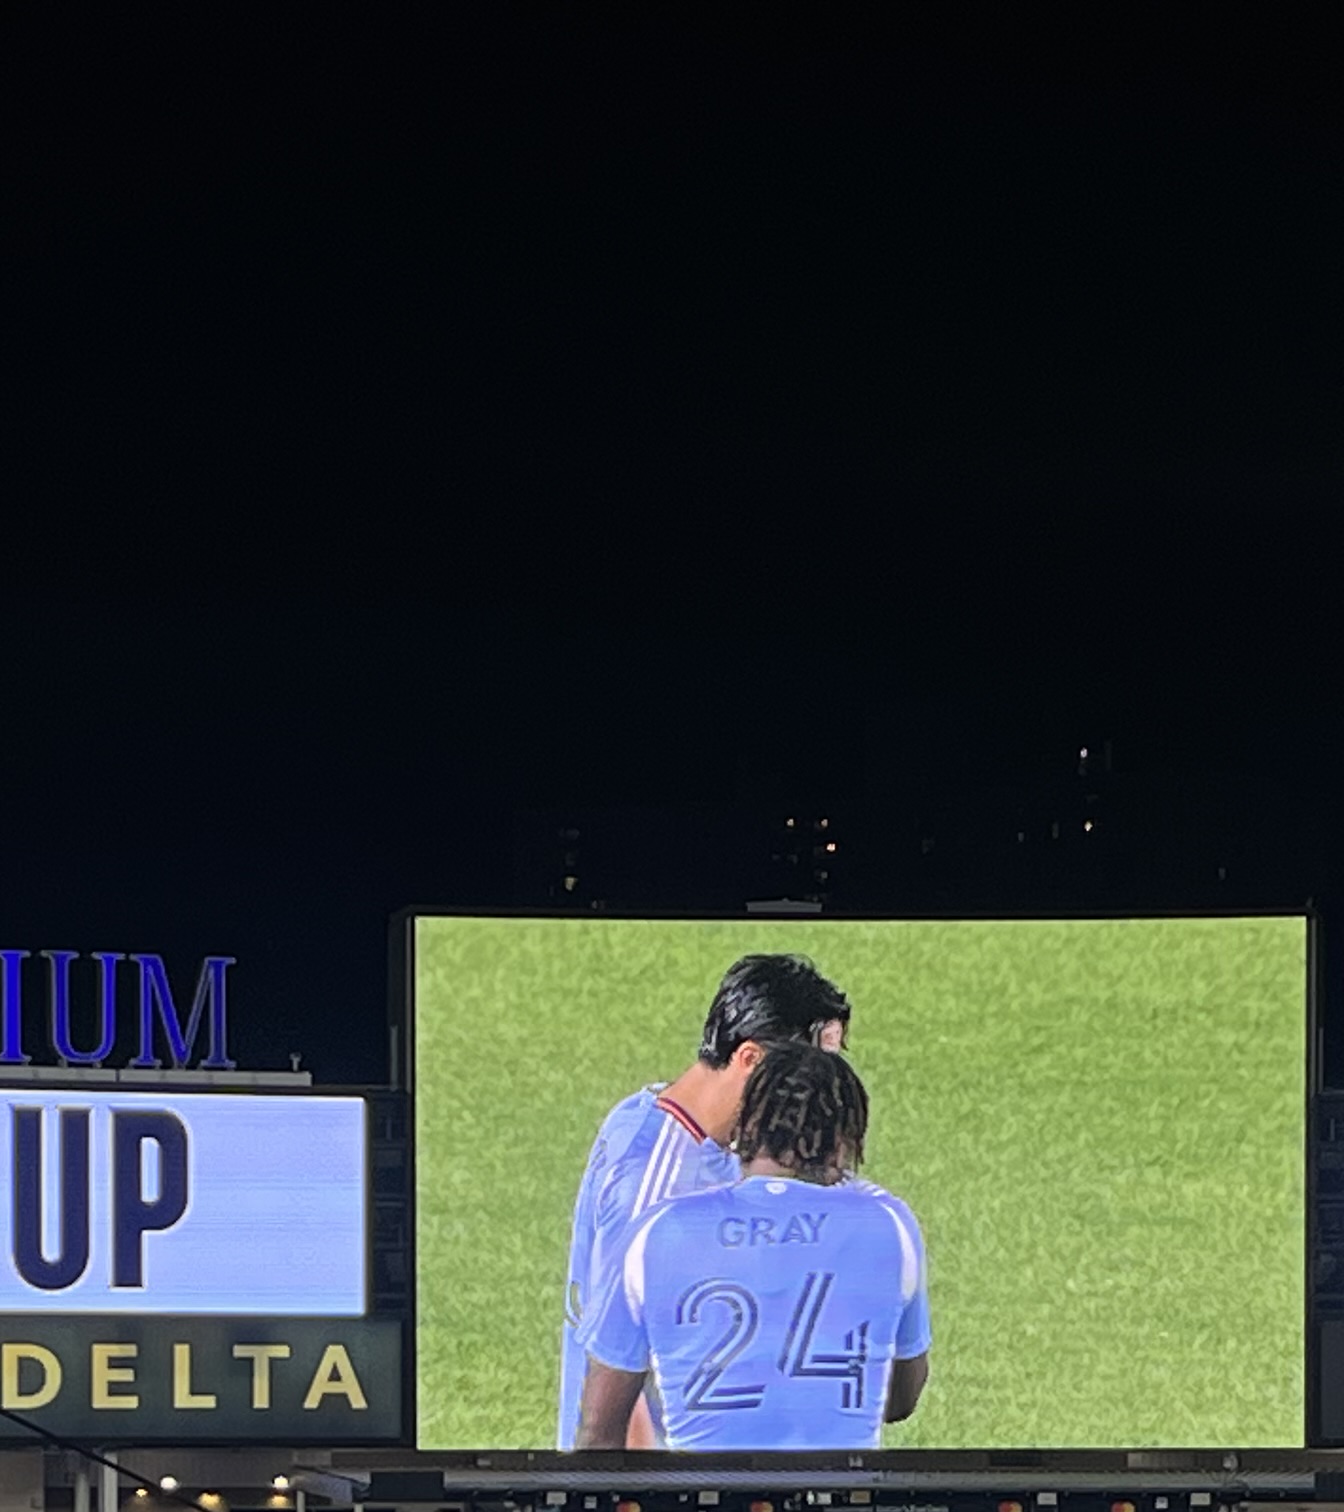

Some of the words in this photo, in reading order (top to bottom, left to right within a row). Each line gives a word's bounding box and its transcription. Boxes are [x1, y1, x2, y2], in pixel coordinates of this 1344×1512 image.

[11, 1105, 189, 1291] UP
[719, 1212, 827, 1247] GRAY
[1, 1342, 368, 1410] DELTA
[675, 1271, 870, 1410] 24
